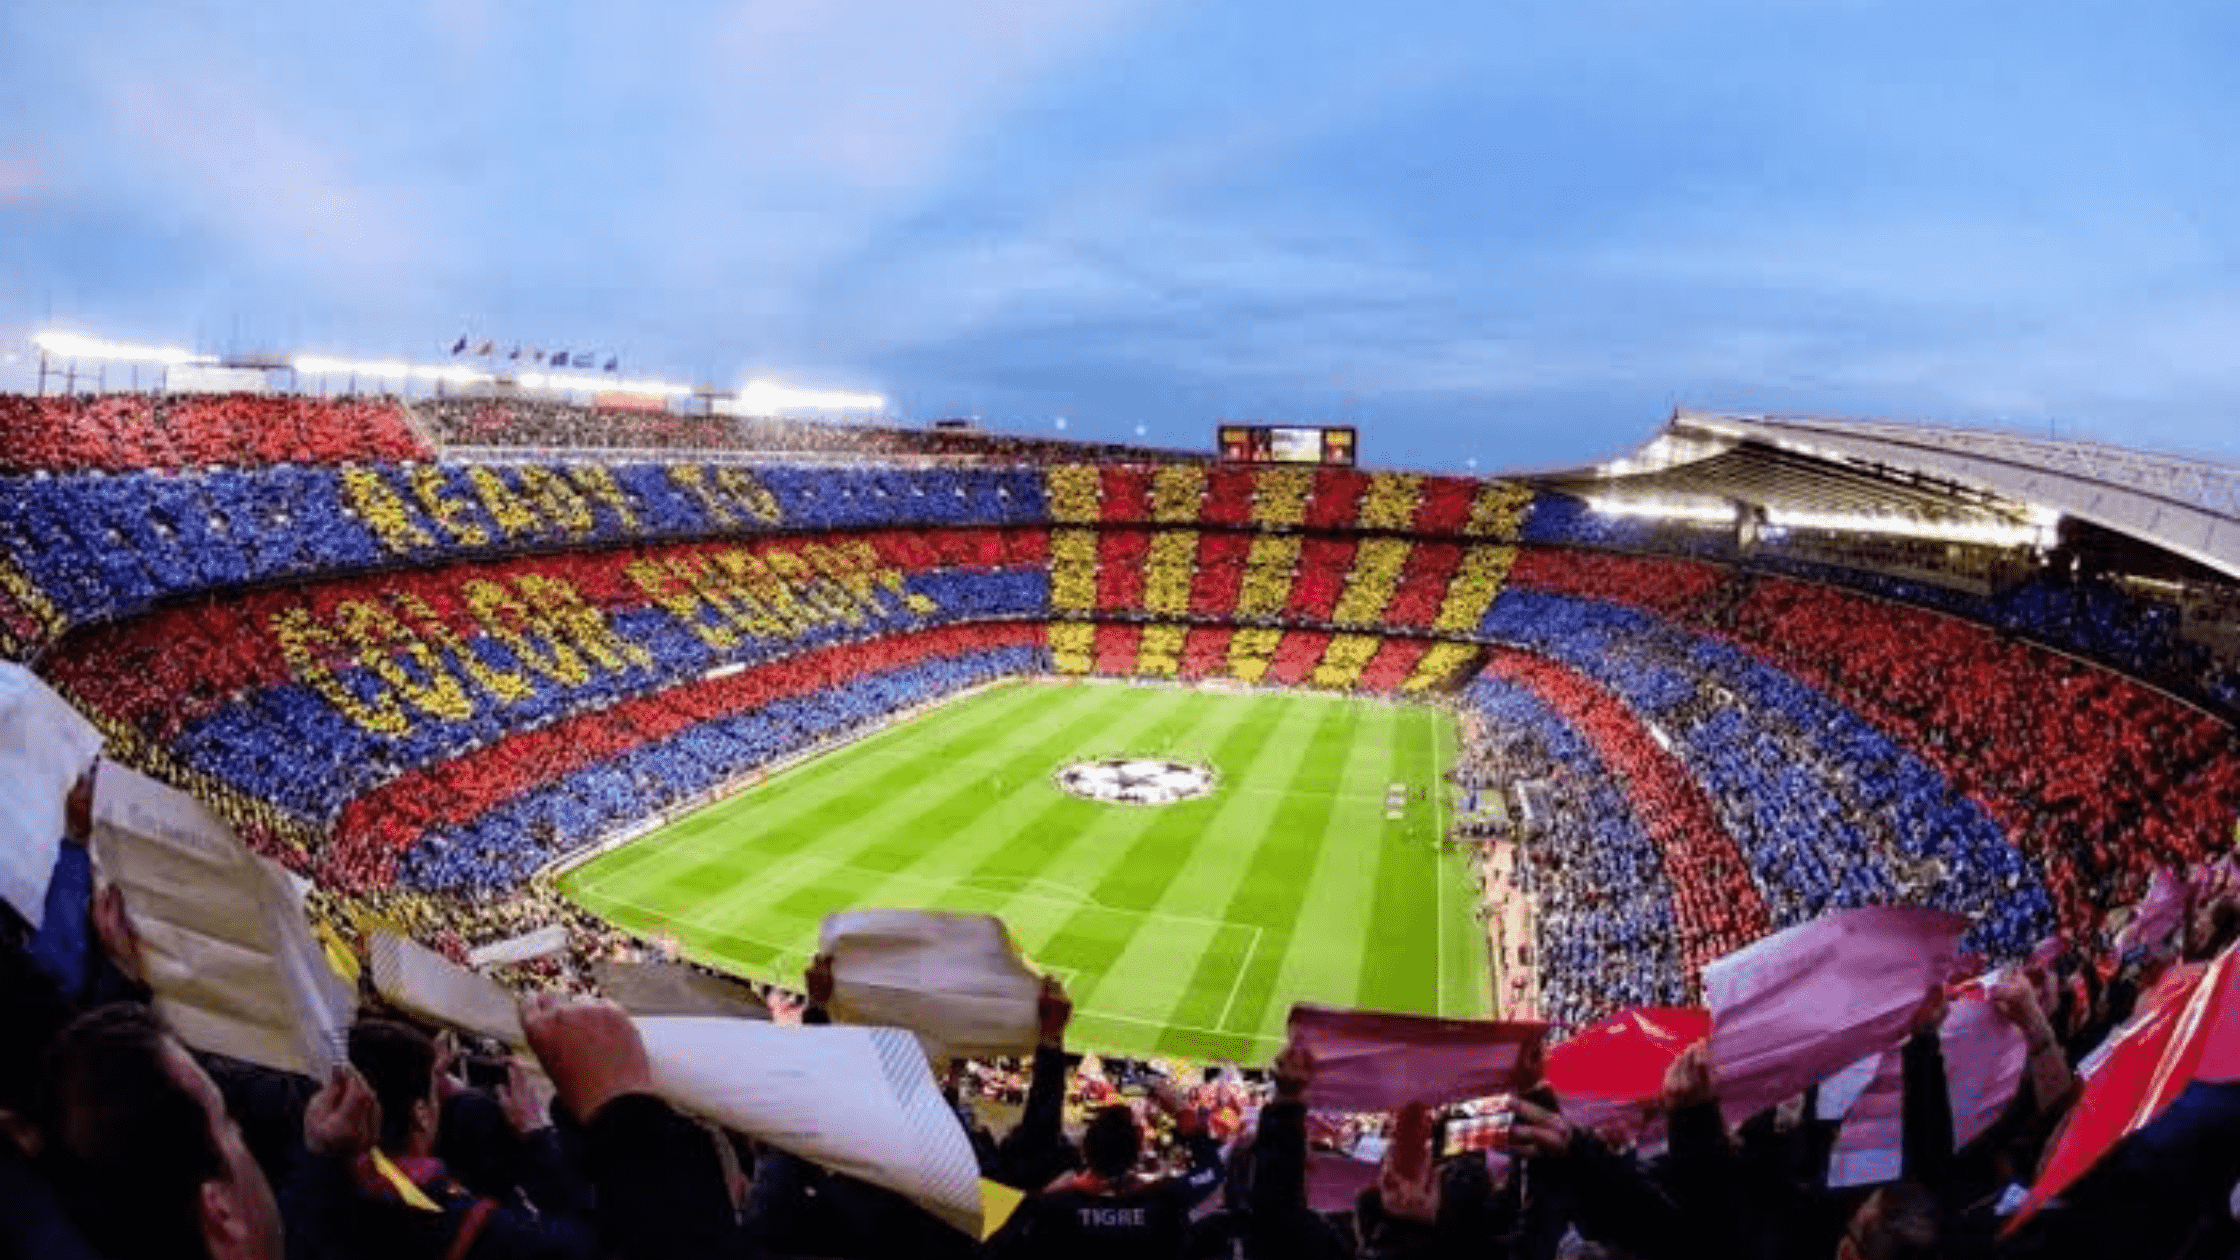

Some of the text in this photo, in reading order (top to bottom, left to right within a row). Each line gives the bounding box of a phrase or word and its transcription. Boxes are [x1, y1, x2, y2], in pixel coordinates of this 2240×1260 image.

[667, 463, 780, 525] TO
[269, 572, 652, 738] COLOR
[1077, 1206, 1146, 1227] TIGRE
